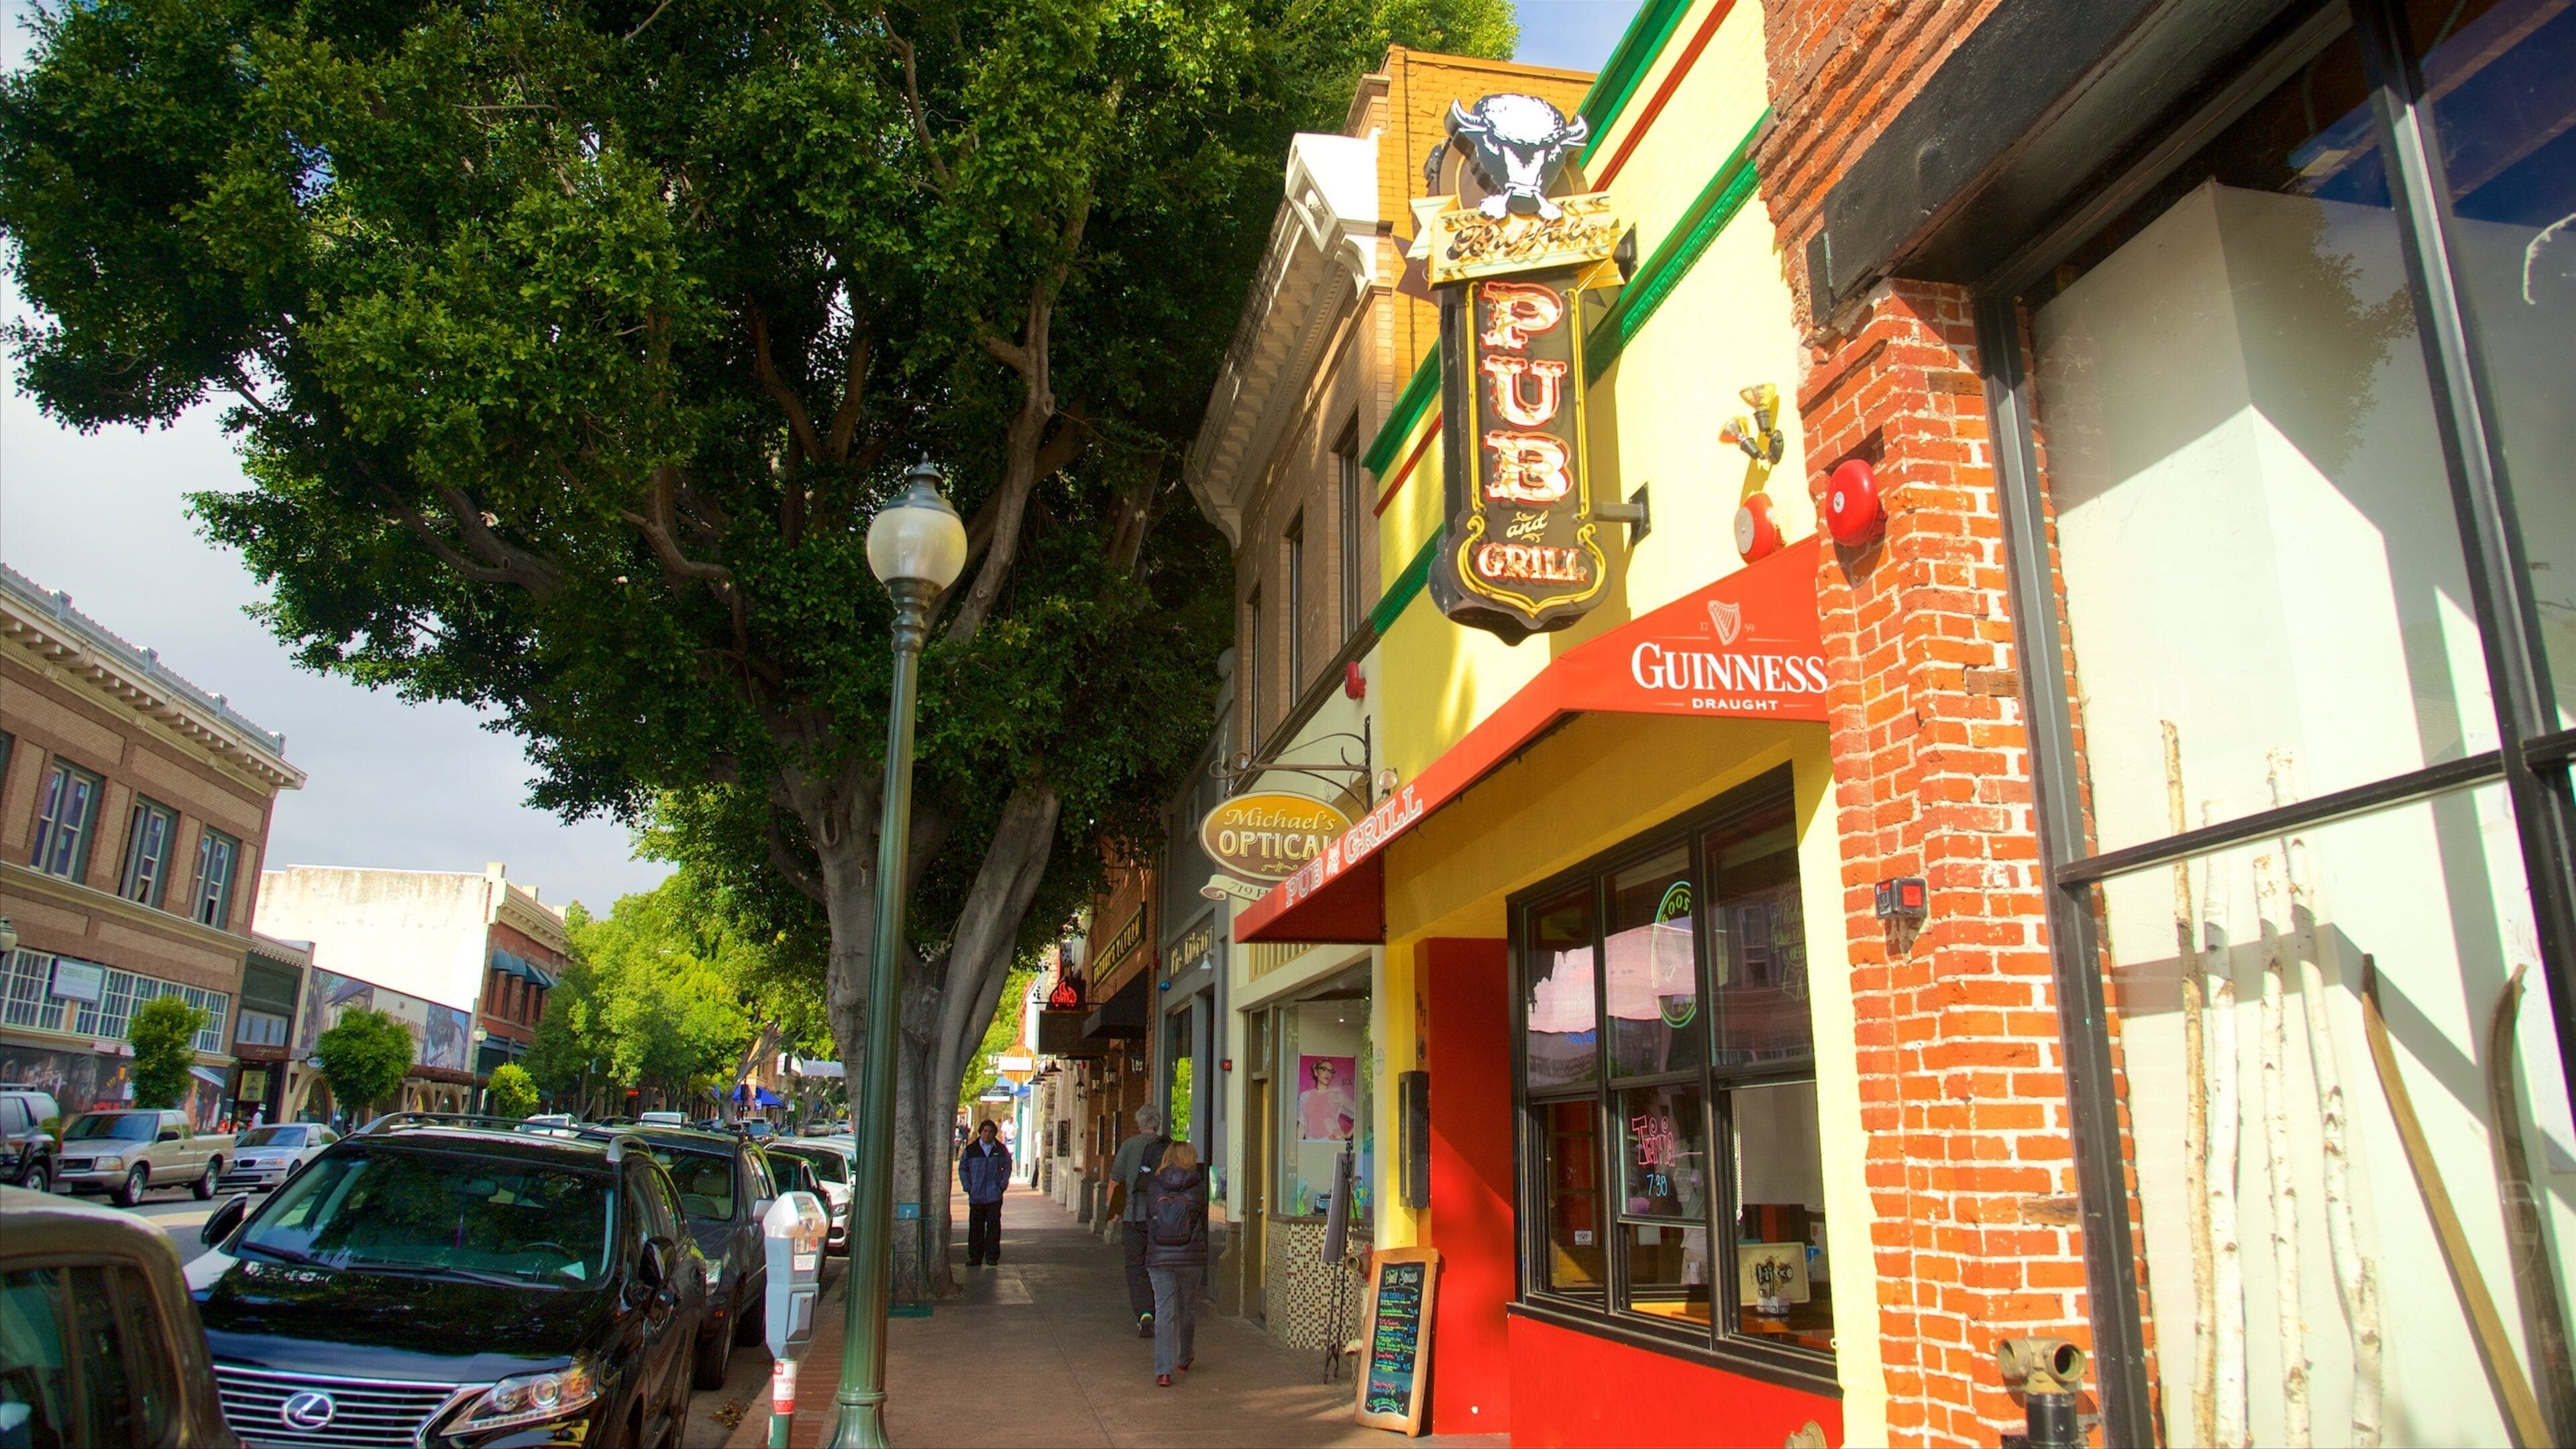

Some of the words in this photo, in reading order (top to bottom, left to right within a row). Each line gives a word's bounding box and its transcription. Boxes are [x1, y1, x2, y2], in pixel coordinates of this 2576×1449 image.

[1481, 282, 1574, 502] PUB
[1506, 510, 1549, 539] and
[1477, 542, 1588, 583] GRILL
[1631, 641, 1828, 694] GUINNESS
[1692, 697, 1778, 711] DRAUGHT
[1223, 807, 1336, 831] Michael's
[1285, 857, 1324, 909] PUB
[1344, 784, 1424, 865] GRILL
[1228, 881, 1253, 896] 719
[1631, 1114, 1676, 1167] Trivia
